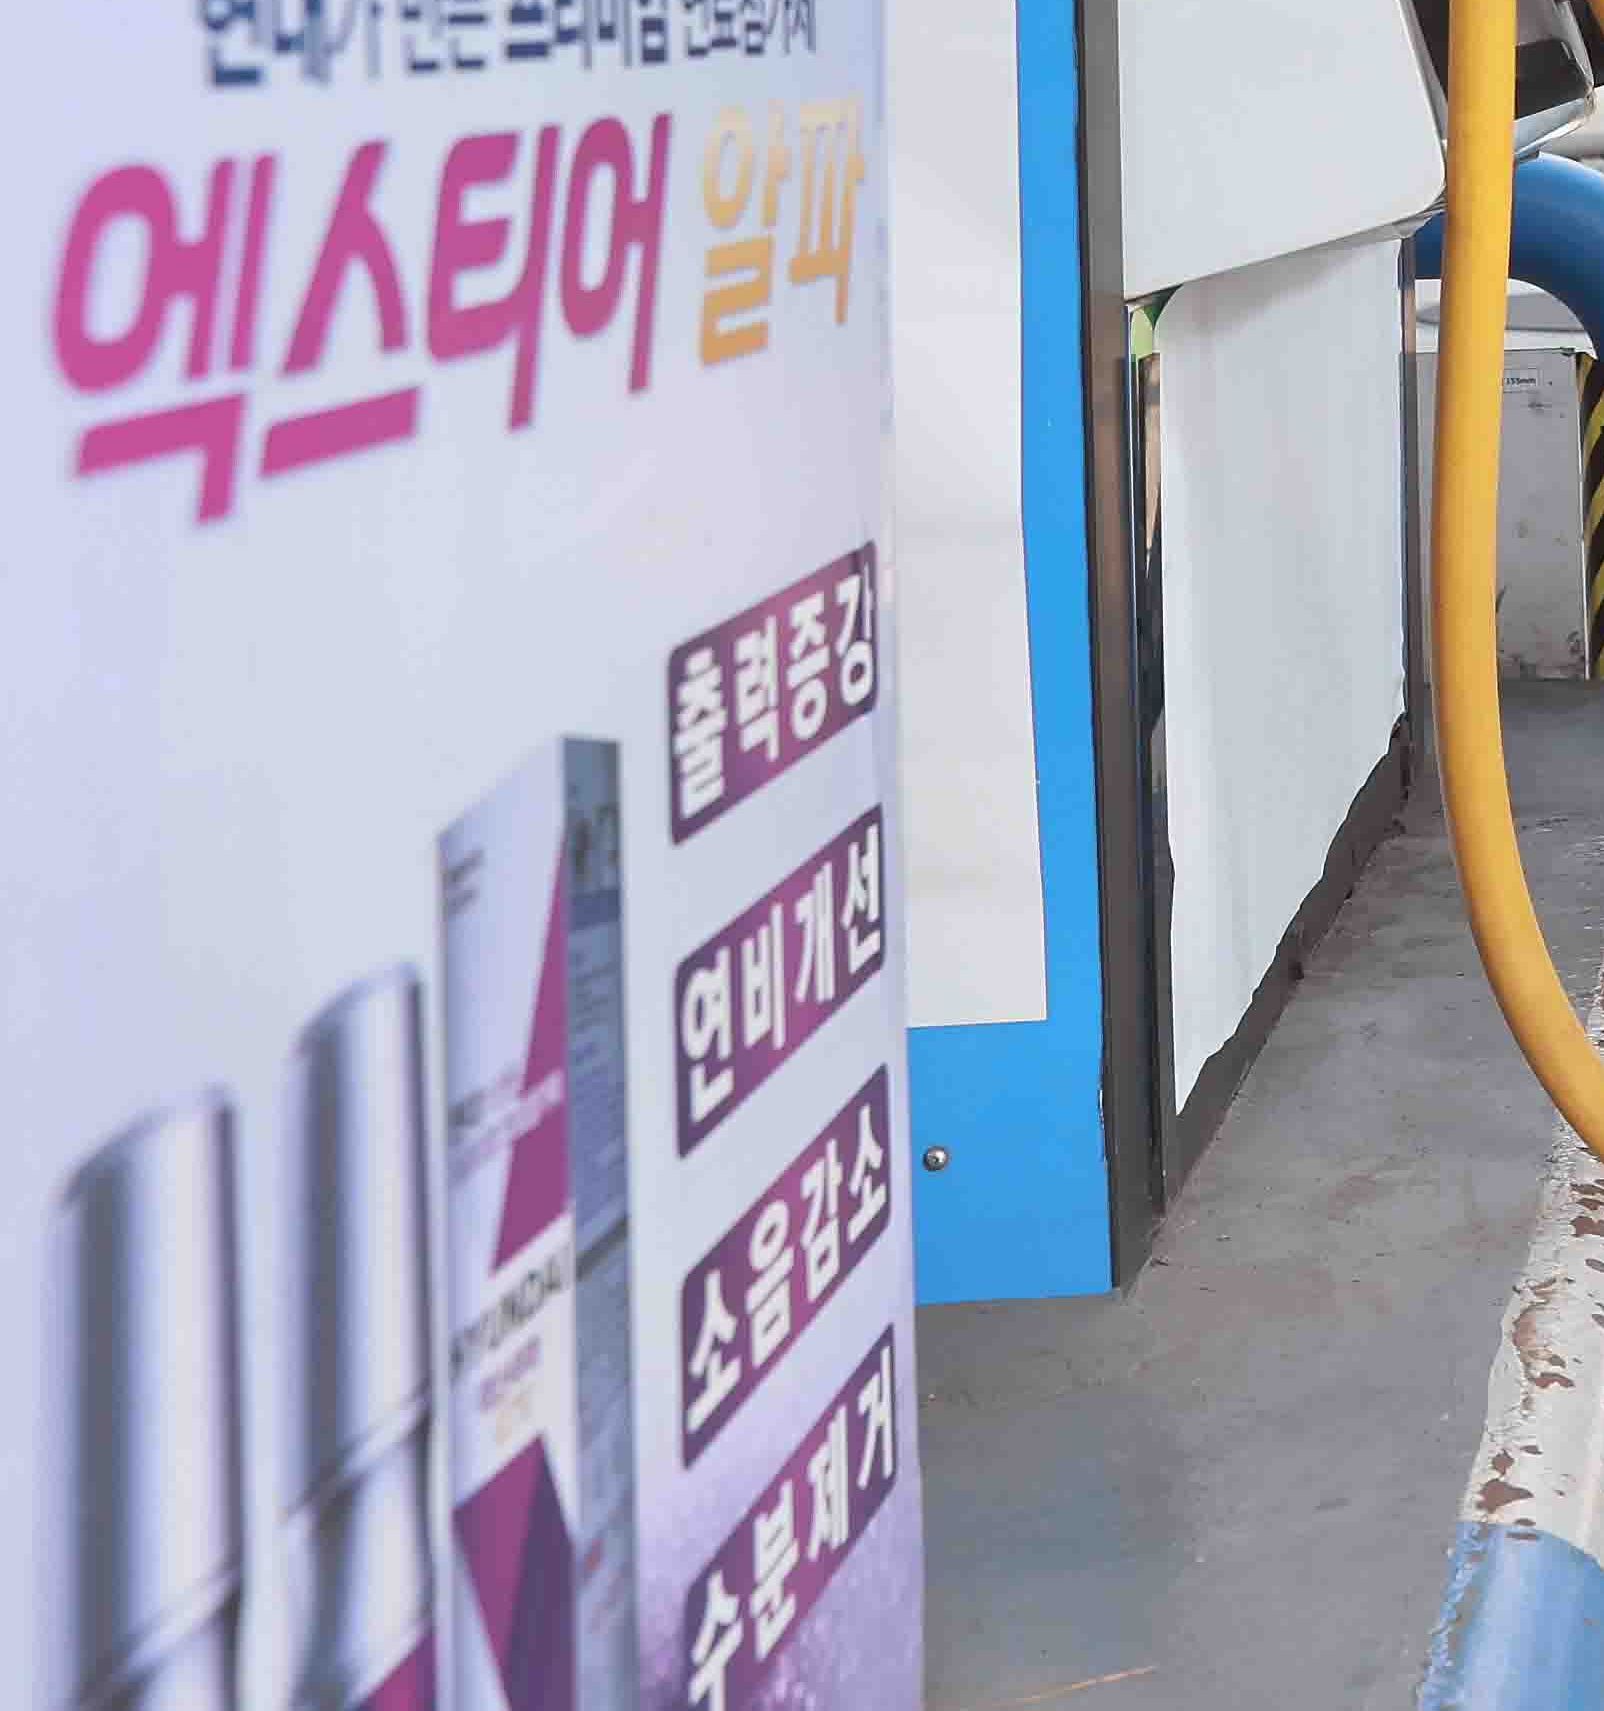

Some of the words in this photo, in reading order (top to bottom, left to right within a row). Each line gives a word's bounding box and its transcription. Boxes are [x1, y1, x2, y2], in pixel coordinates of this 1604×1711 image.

[50, 111, 673, 528] 엑스티어
[698, 89, 868, 368] 알파
[673, 560, 874, 821] 출력증강
[680, 820, 882, 1122] 연비개선
[685, 1103, 889, 1433] 소음감소
[687, 1343, 894, 1711] 수분제거
